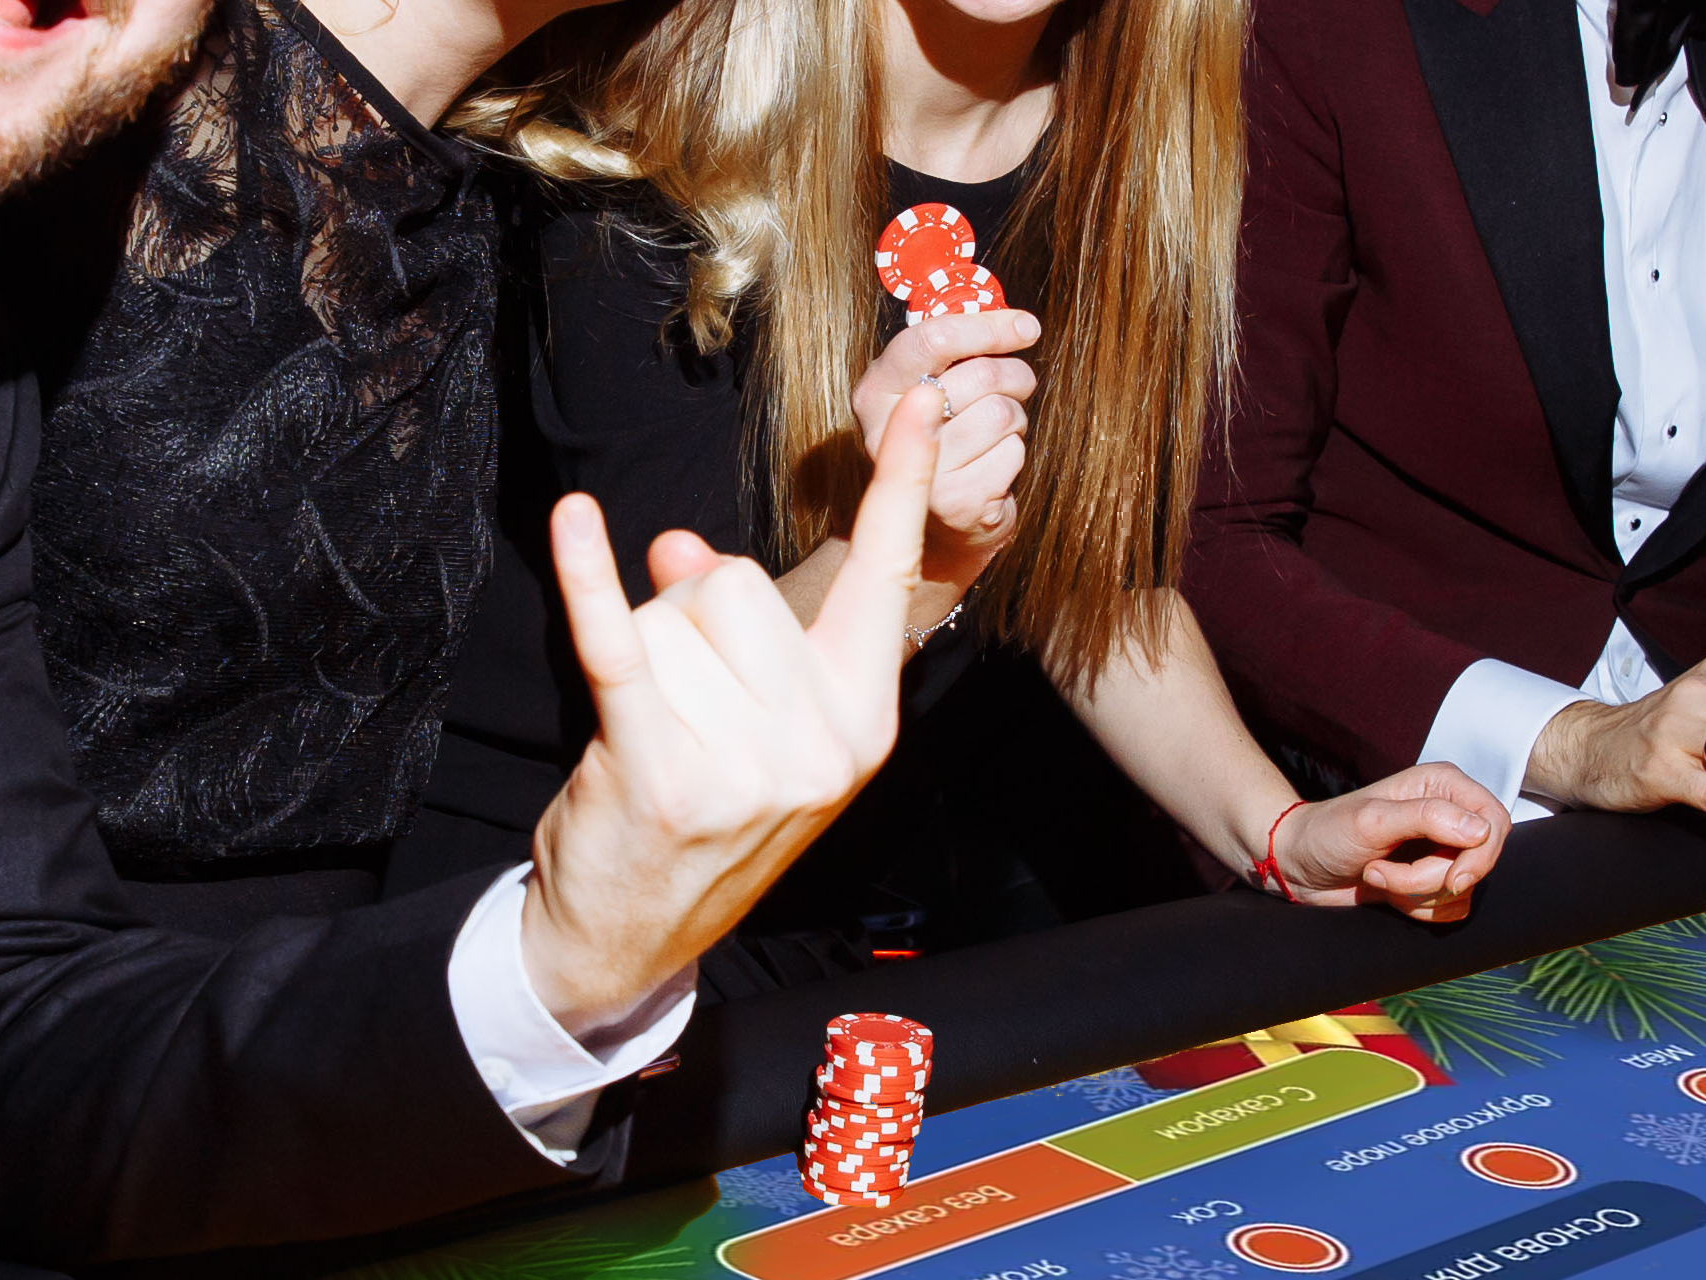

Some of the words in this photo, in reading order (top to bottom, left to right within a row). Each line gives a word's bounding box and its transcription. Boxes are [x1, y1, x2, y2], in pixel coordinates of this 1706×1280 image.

[1621, 1044, 1694, 1069] Мёд
[1290, 1085, 1317, 1104] С
[1155, 1094, 1284, 1140] сахаром
[1402, 1093, 1552, 1148] Фруктовое
[1325, 1139, 1406, 1174] пюре
[950, 1184, 1016, 1211] Без
[1171, 1200, 1243, 1225] Сок
[828, 1205, 948, 1246] сахара
[1495, 1207, 1640, 1264] Основа
